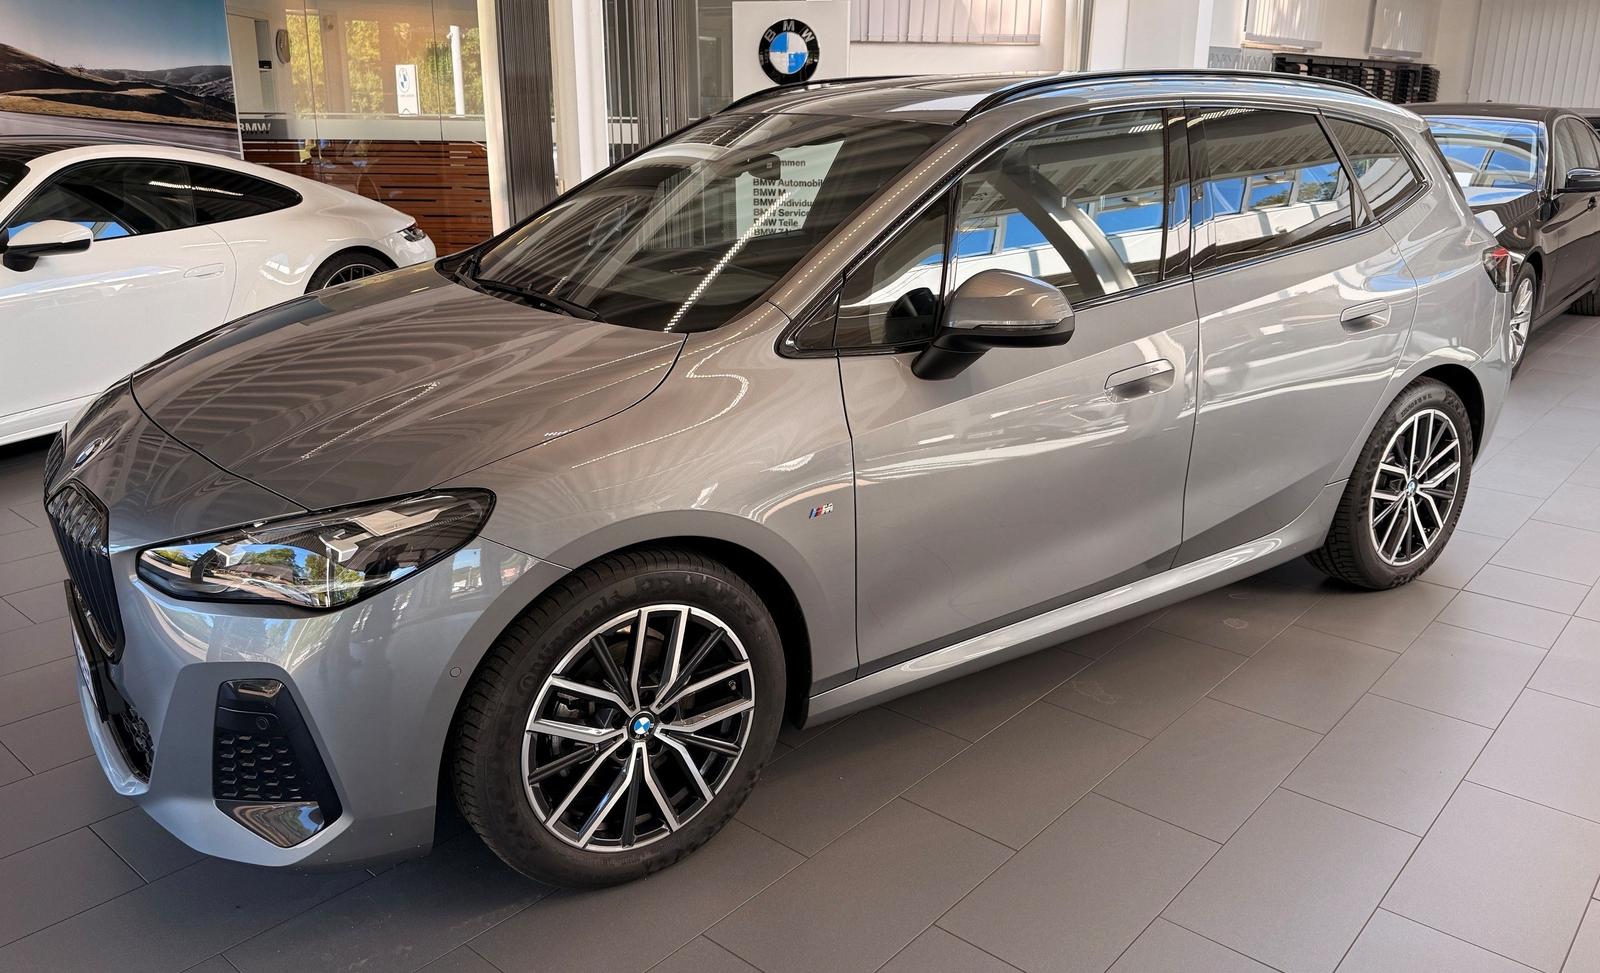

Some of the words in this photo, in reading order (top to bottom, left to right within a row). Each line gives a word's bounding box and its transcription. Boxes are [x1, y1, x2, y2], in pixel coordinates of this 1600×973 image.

[764, 20, 815, 43] BMW
[753, 178, 776, 186] BMW
[753, 188, 776, 196] BMW
[753, 198, 776, 206] BMW
[778, 218, 798, 226] Teile
